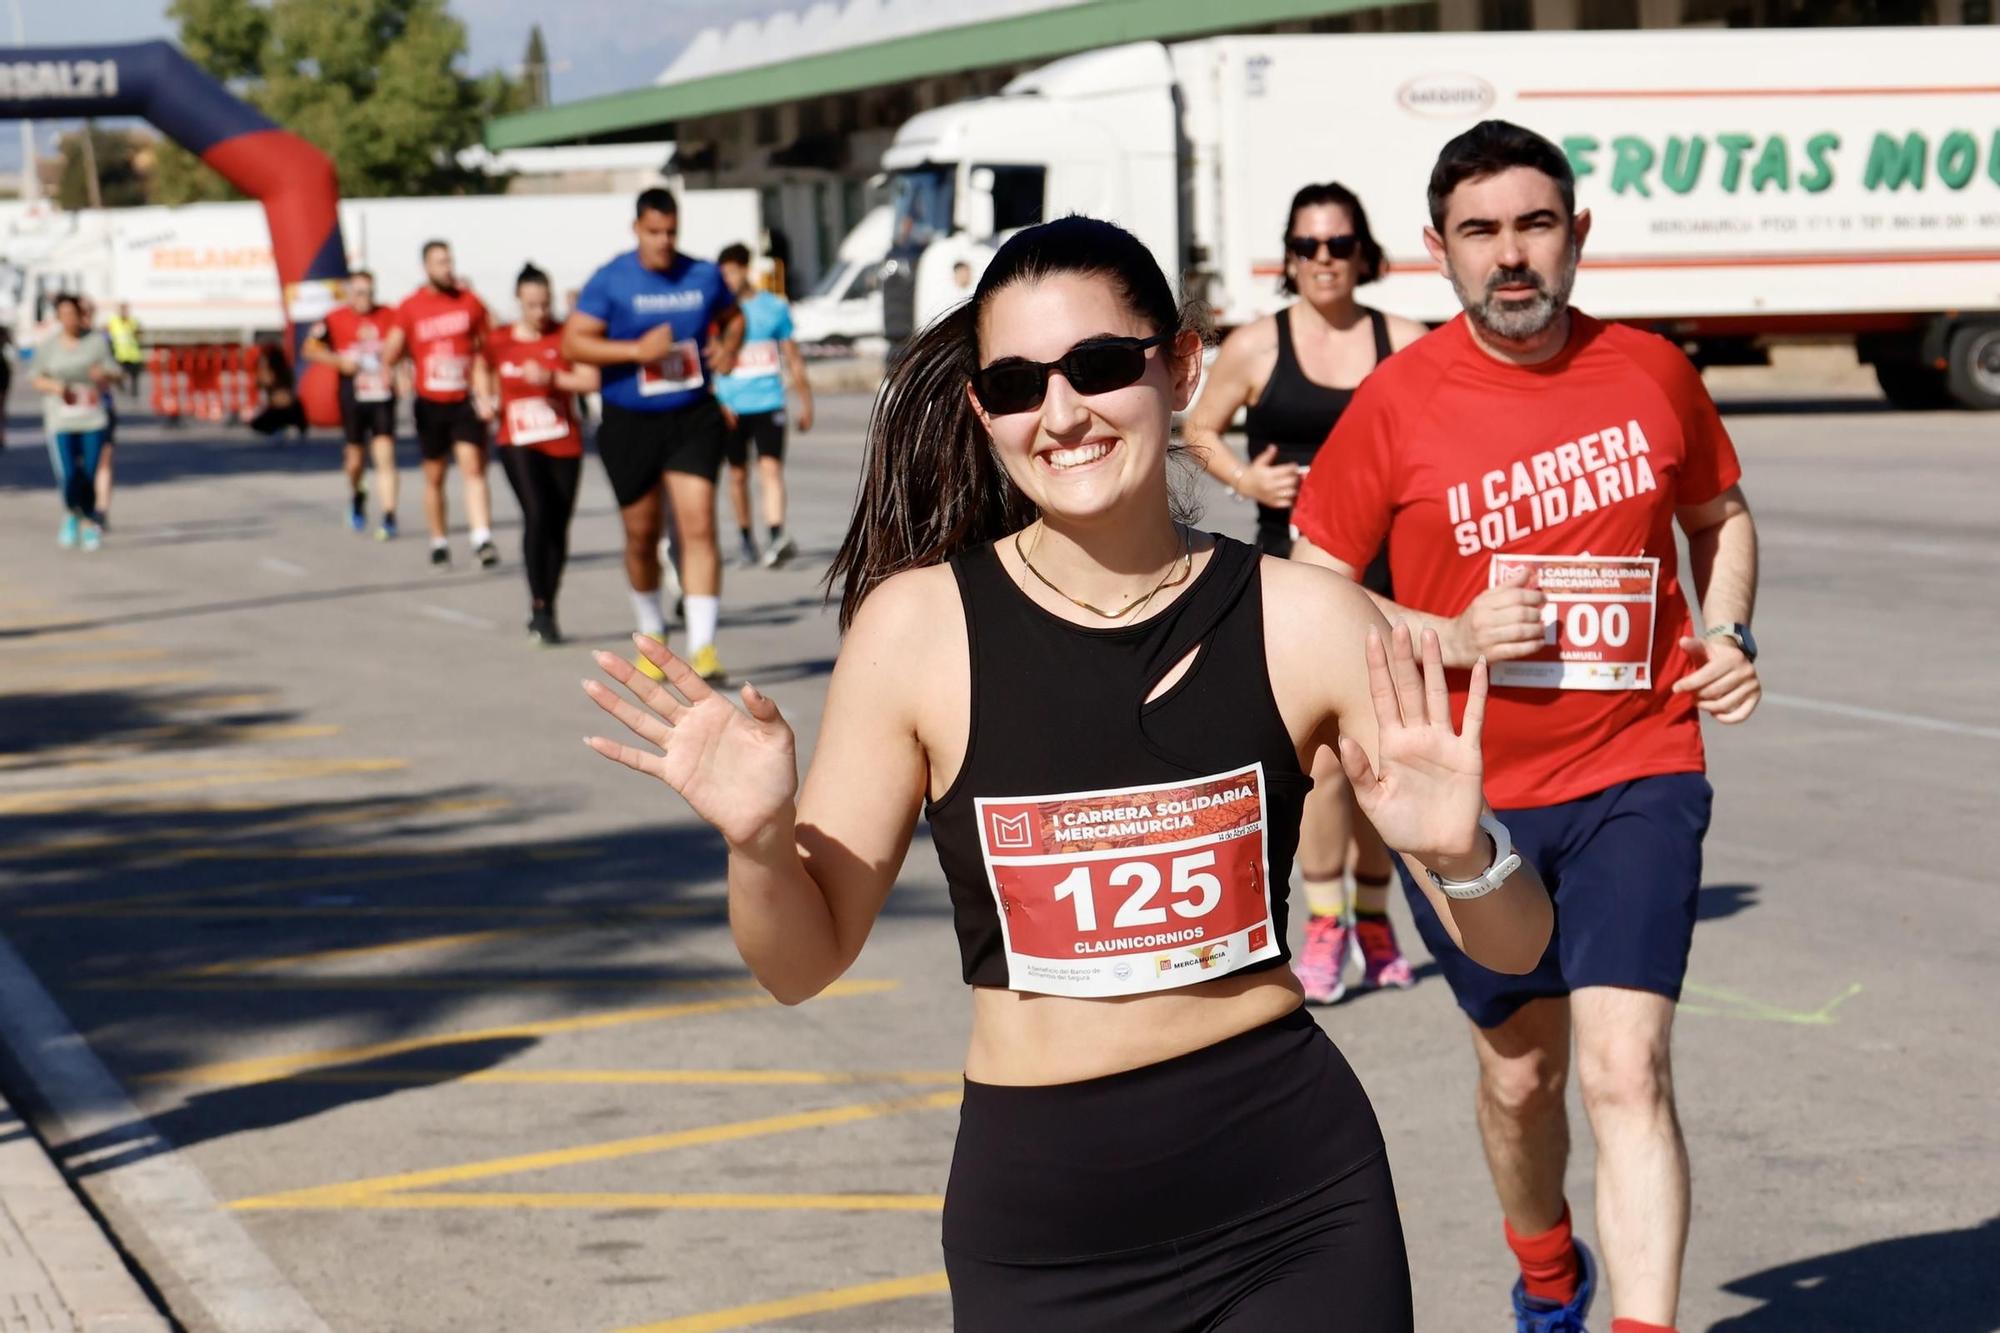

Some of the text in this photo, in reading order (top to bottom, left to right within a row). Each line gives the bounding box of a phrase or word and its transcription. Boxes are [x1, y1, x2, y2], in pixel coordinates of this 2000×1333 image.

[1562, 132, 1840, 198] FRUTAS
[1447, 420, 1650, 525] II CARRERA
[1455, 455, 1657, 557] SOLIDARIA
[1538, 577, 1620, 588] MERCAMURCIA
[1545, 568, 1598, 578] CARRERA
[1601, 569, 1651, 578] SOLIDARIA
[1053, 785, 1253, 827] I CARRERA SOLIDARIA
[1055, 815, 1194, 842] MERCAMURCIA
[1053, 850, 1222, 932] 125
[1074, 927, 1204, 954] CLAUNICORNIOS
[1174, 951, 1226, 969] MERCAMURCIA
